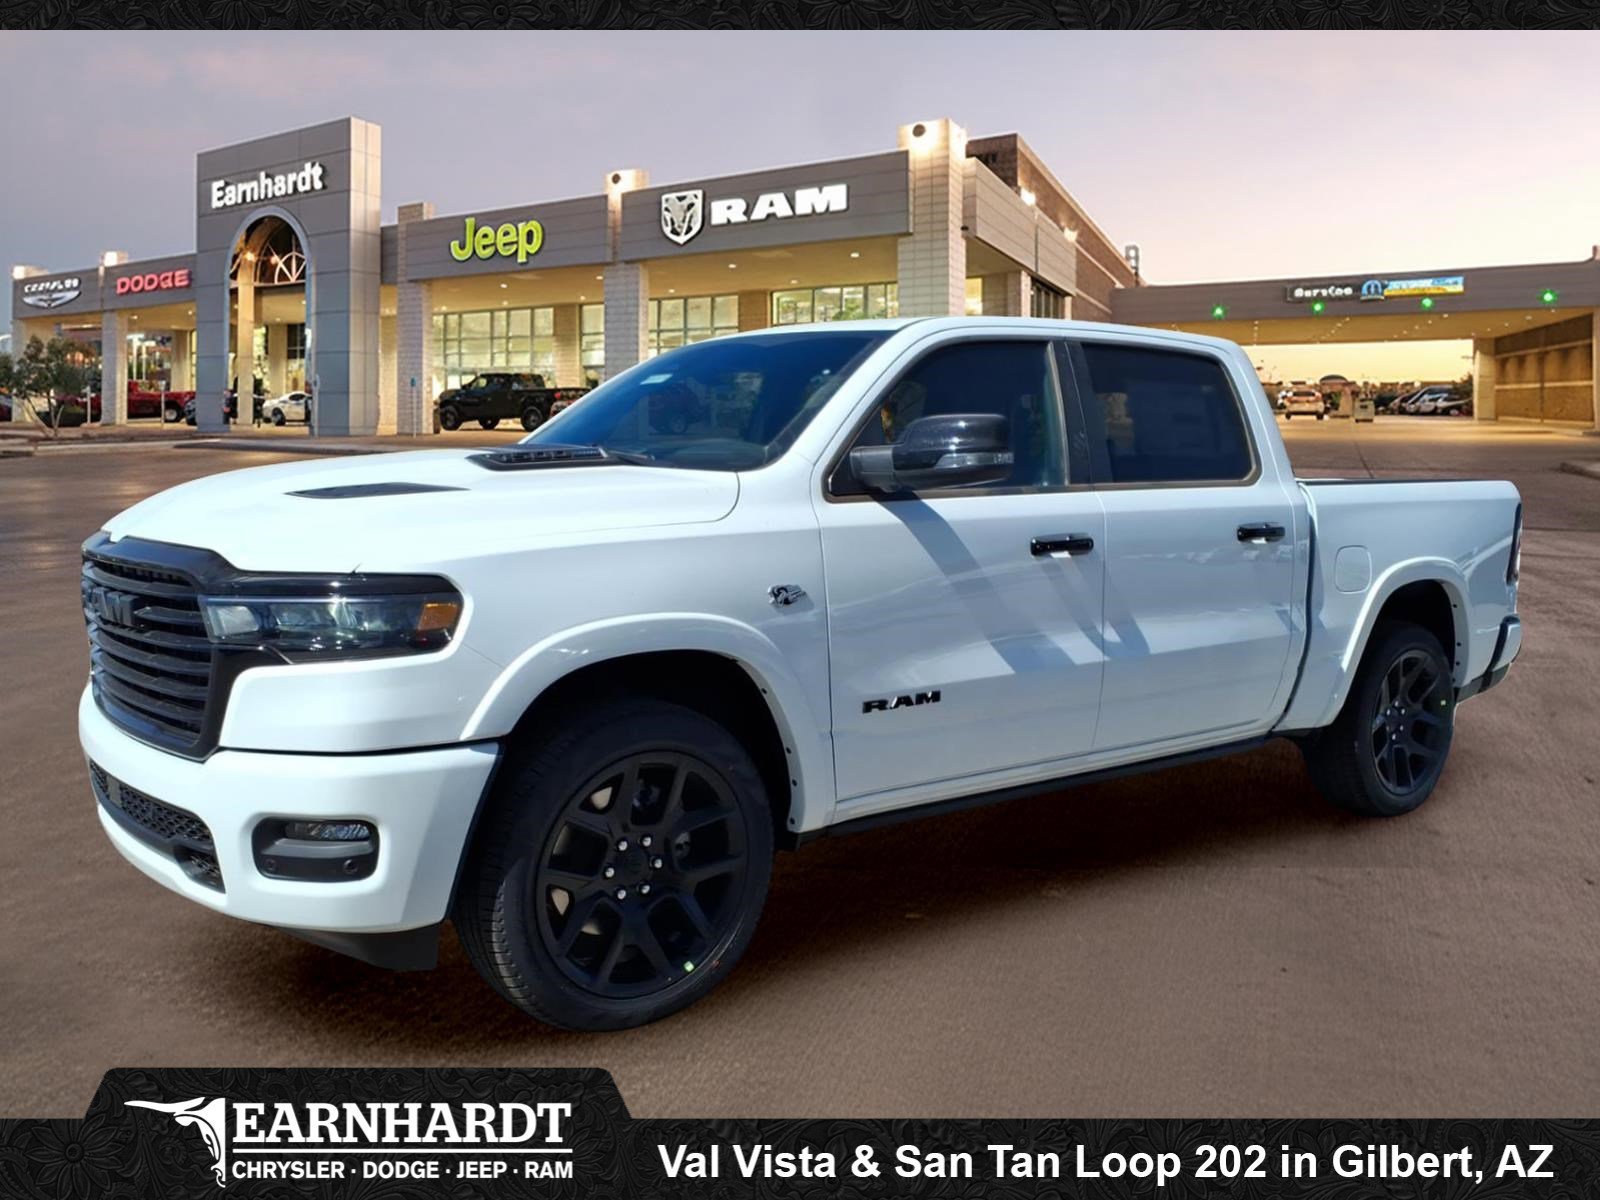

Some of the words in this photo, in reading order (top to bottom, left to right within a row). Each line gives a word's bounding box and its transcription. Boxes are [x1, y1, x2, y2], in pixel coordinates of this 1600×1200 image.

[211, 162, 324, 209] Earnhardt
[710, 183, 848, 226] RAM
[450, 217, 543, 264] Jeep
[116, 269, 190, 295] DODGE
[862, 690, 941, 714] RAM
